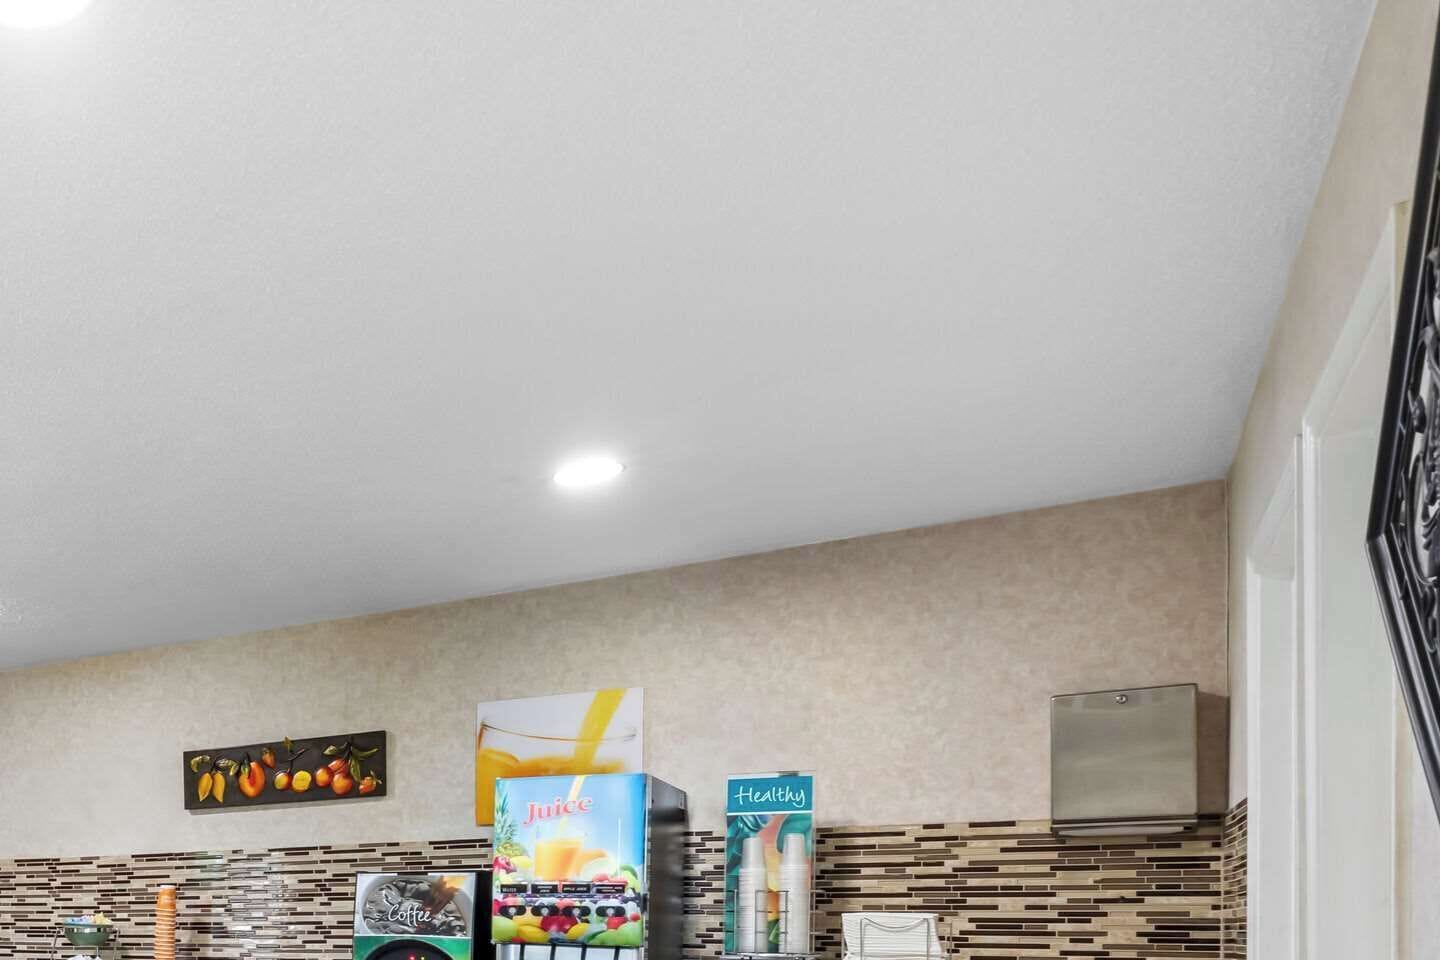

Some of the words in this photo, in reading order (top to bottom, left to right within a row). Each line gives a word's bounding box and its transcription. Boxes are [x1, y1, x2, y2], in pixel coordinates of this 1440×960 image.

[734, 785, 806, 808] Healthy
[523, 796, 593, 827] Juice
[388, 904, 432, 927] Coffee
